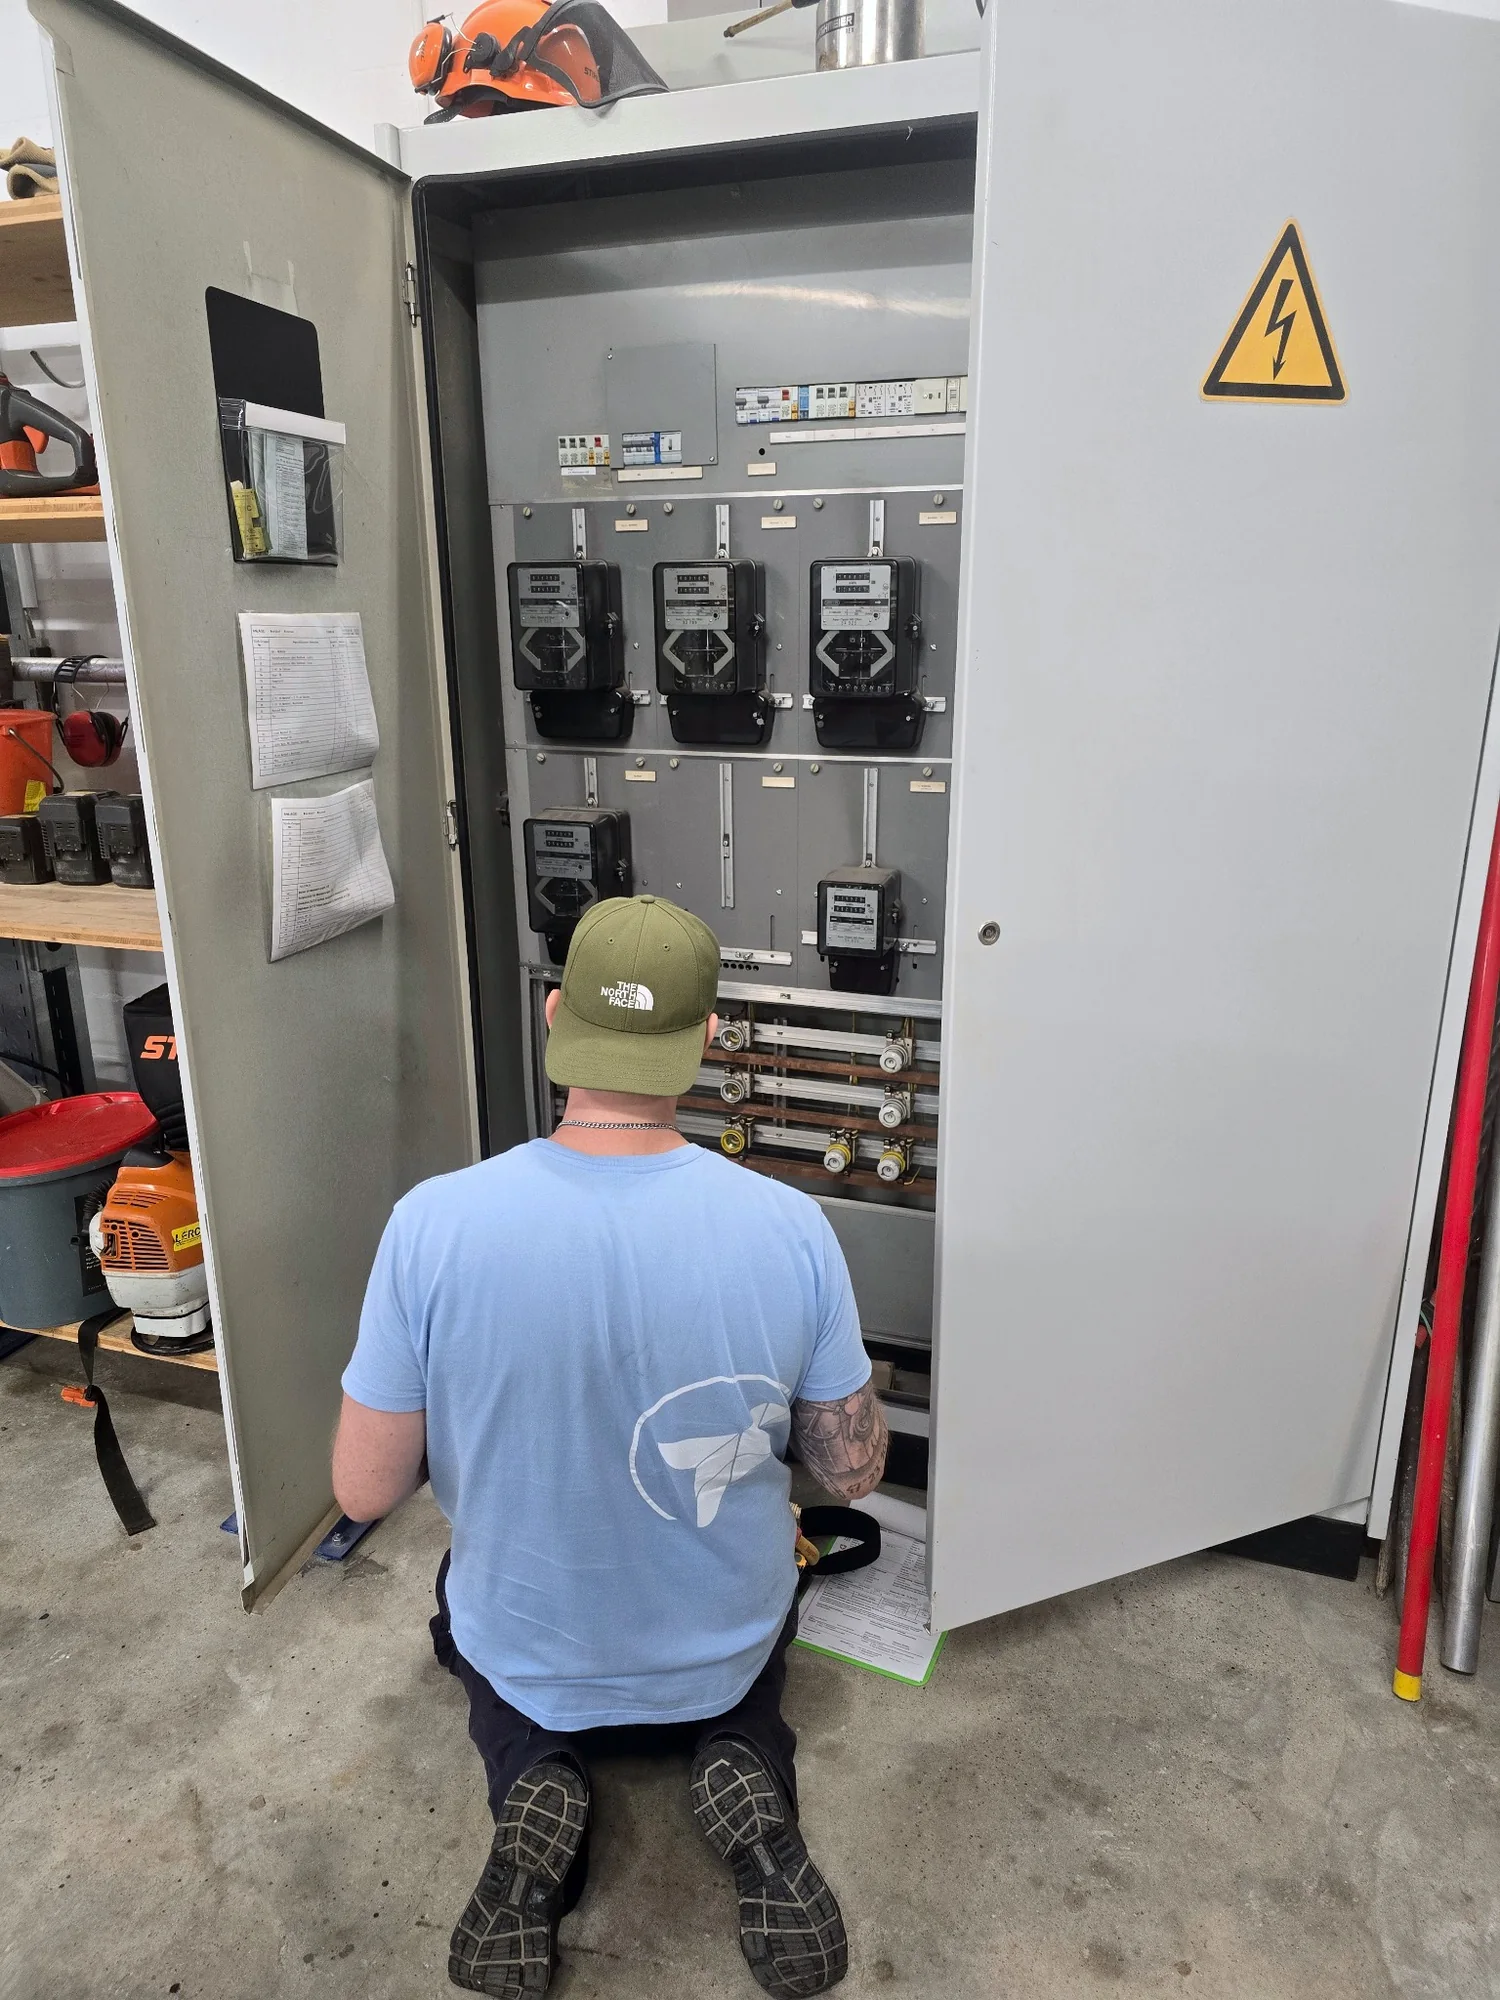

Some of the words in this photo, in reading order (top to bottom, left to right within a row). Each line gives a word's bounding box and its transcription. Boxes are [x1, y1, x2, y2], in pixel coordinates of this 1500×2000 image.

[601, 986, 636, 1000] NORTH
[617, 981, 637, 993] THE
[609, 997, 635, 1009] FACE
